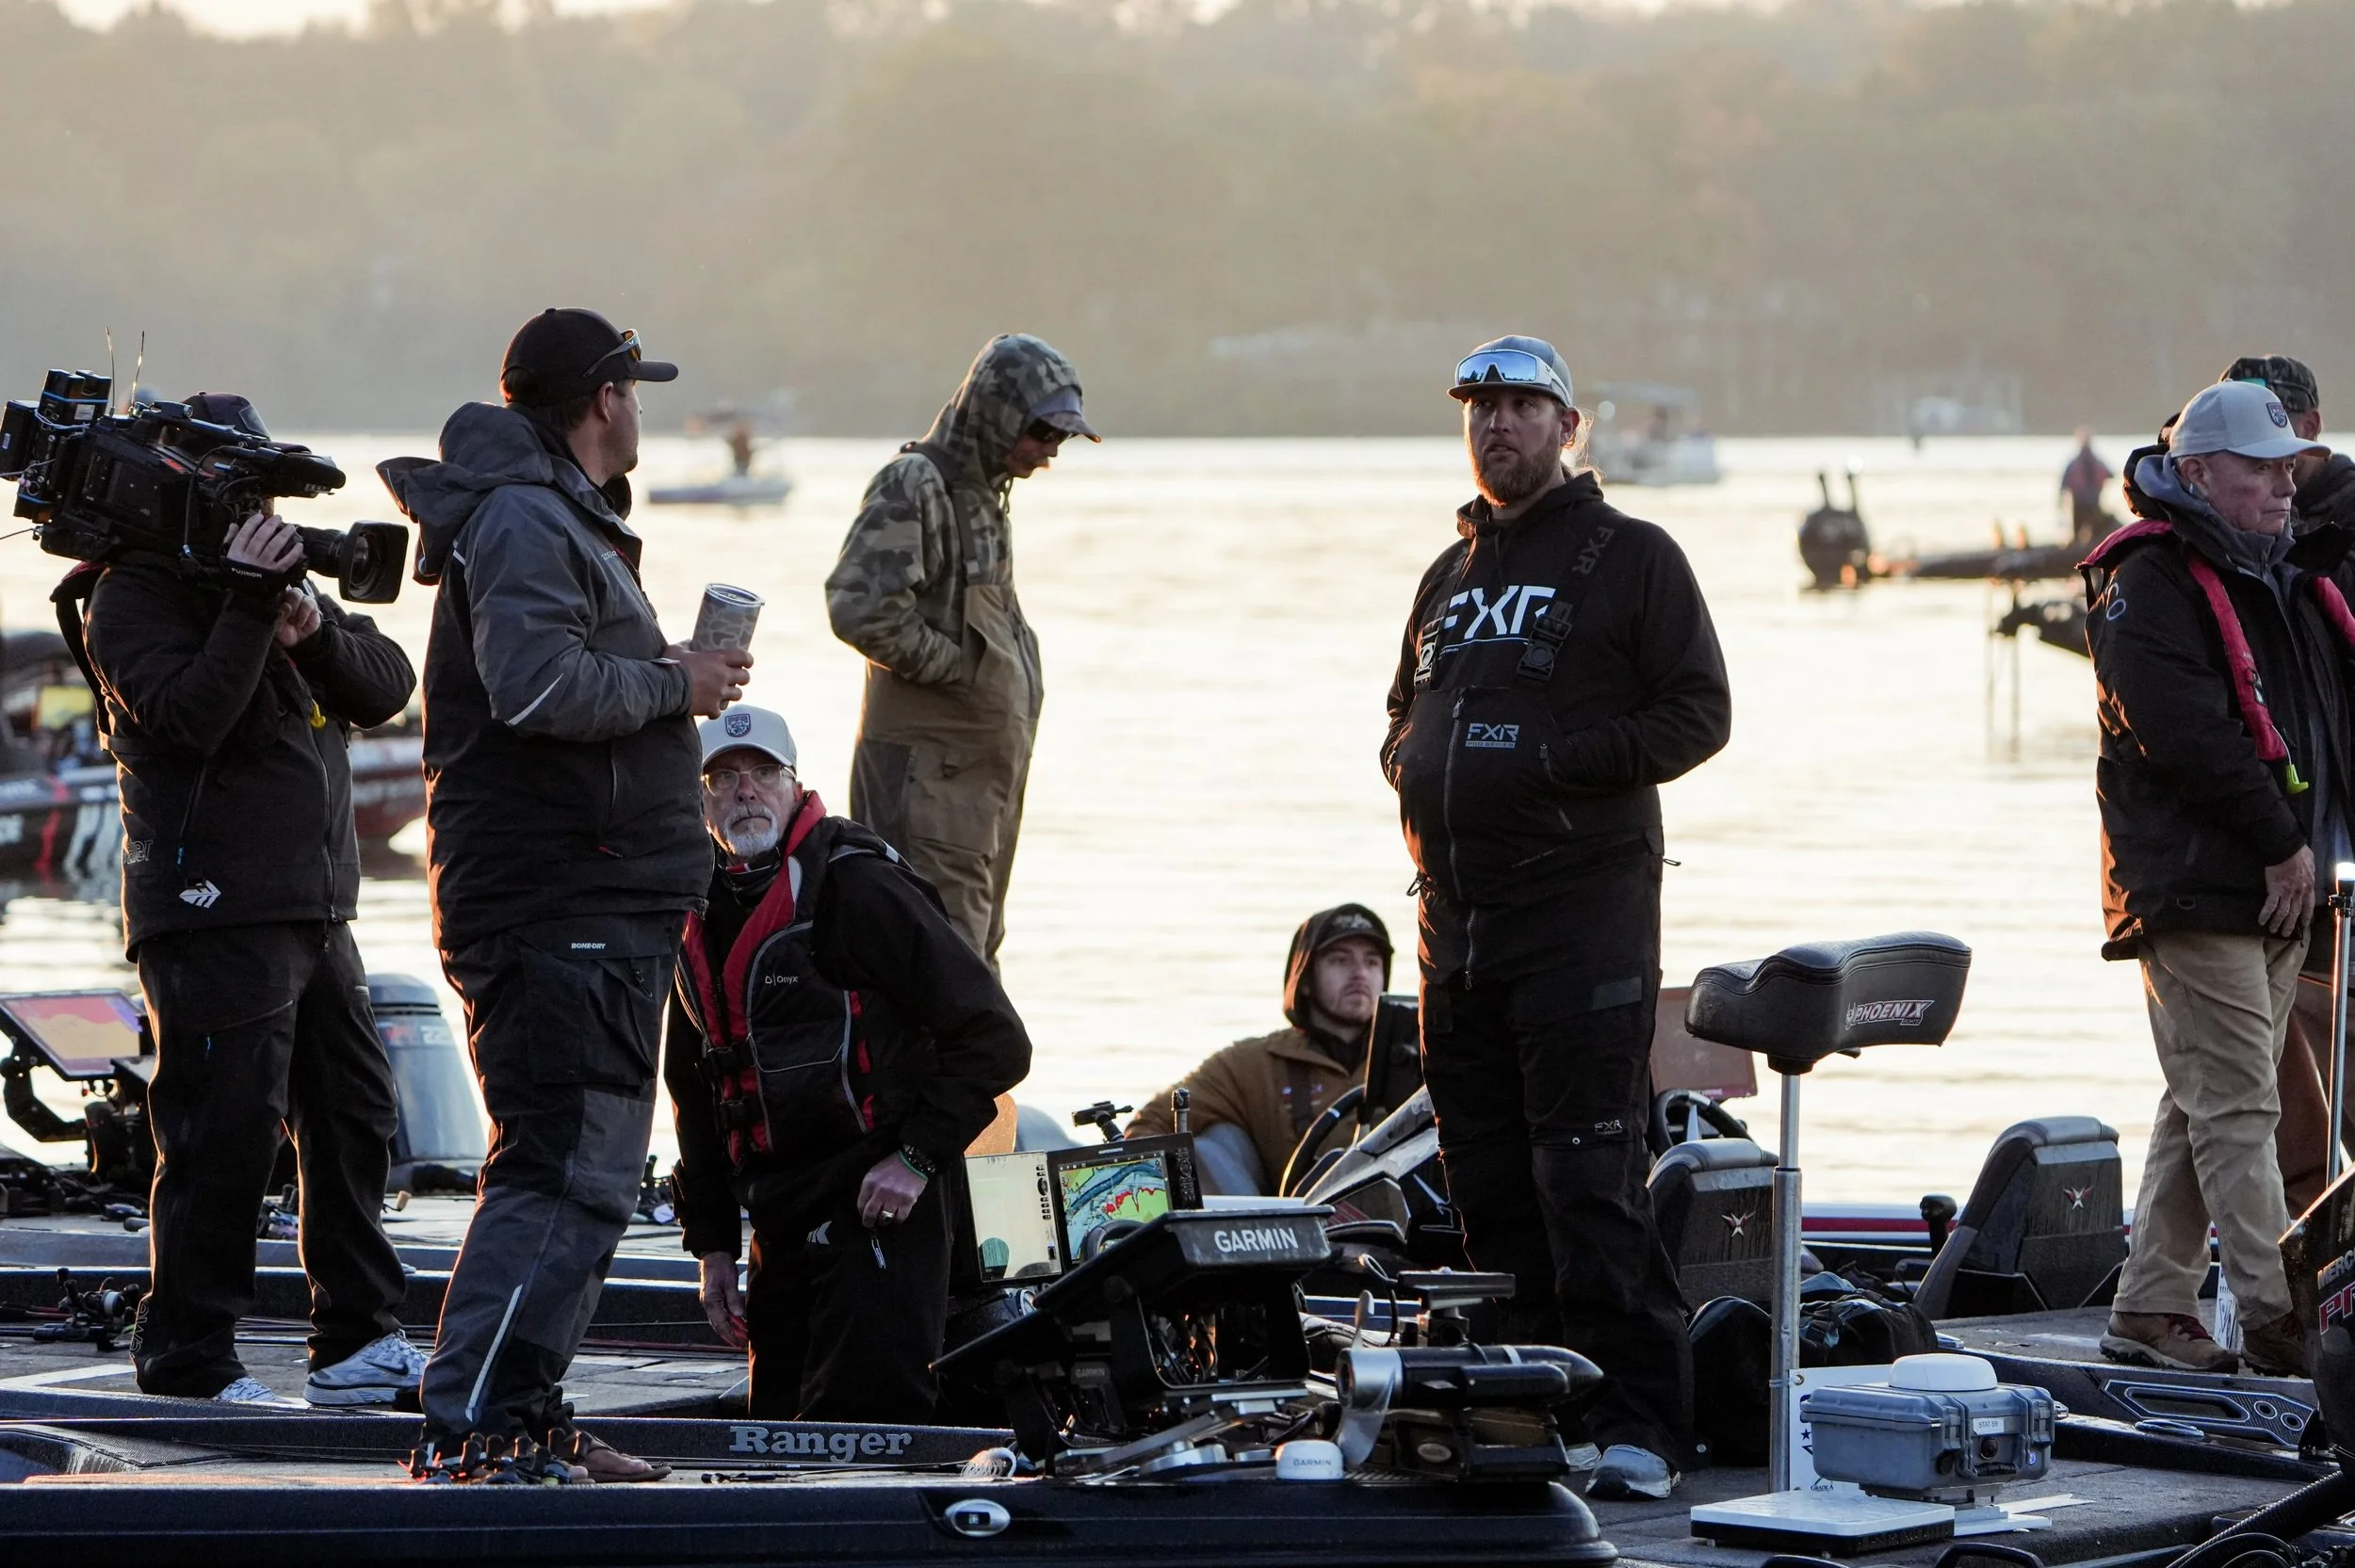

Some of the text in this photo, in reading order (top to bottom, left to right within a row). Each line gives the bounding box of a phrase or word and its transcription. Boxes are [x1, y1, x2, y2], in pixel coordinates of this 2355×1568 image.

[231, 567, 263, 578] FUJINON
[1467, 722, 1520, 741] FXR
[776, 975, 799, 985] Onyx
[1854, 1000, 1932, 1023] PHOENIX
[1594, 1120, 1623, 1132] FXR
[1213, 1227, 1299, 1253] GARMIN
[2317, 1249, 2355, 1291] MERC
[729, 1426, 913, 1463] Ranger
